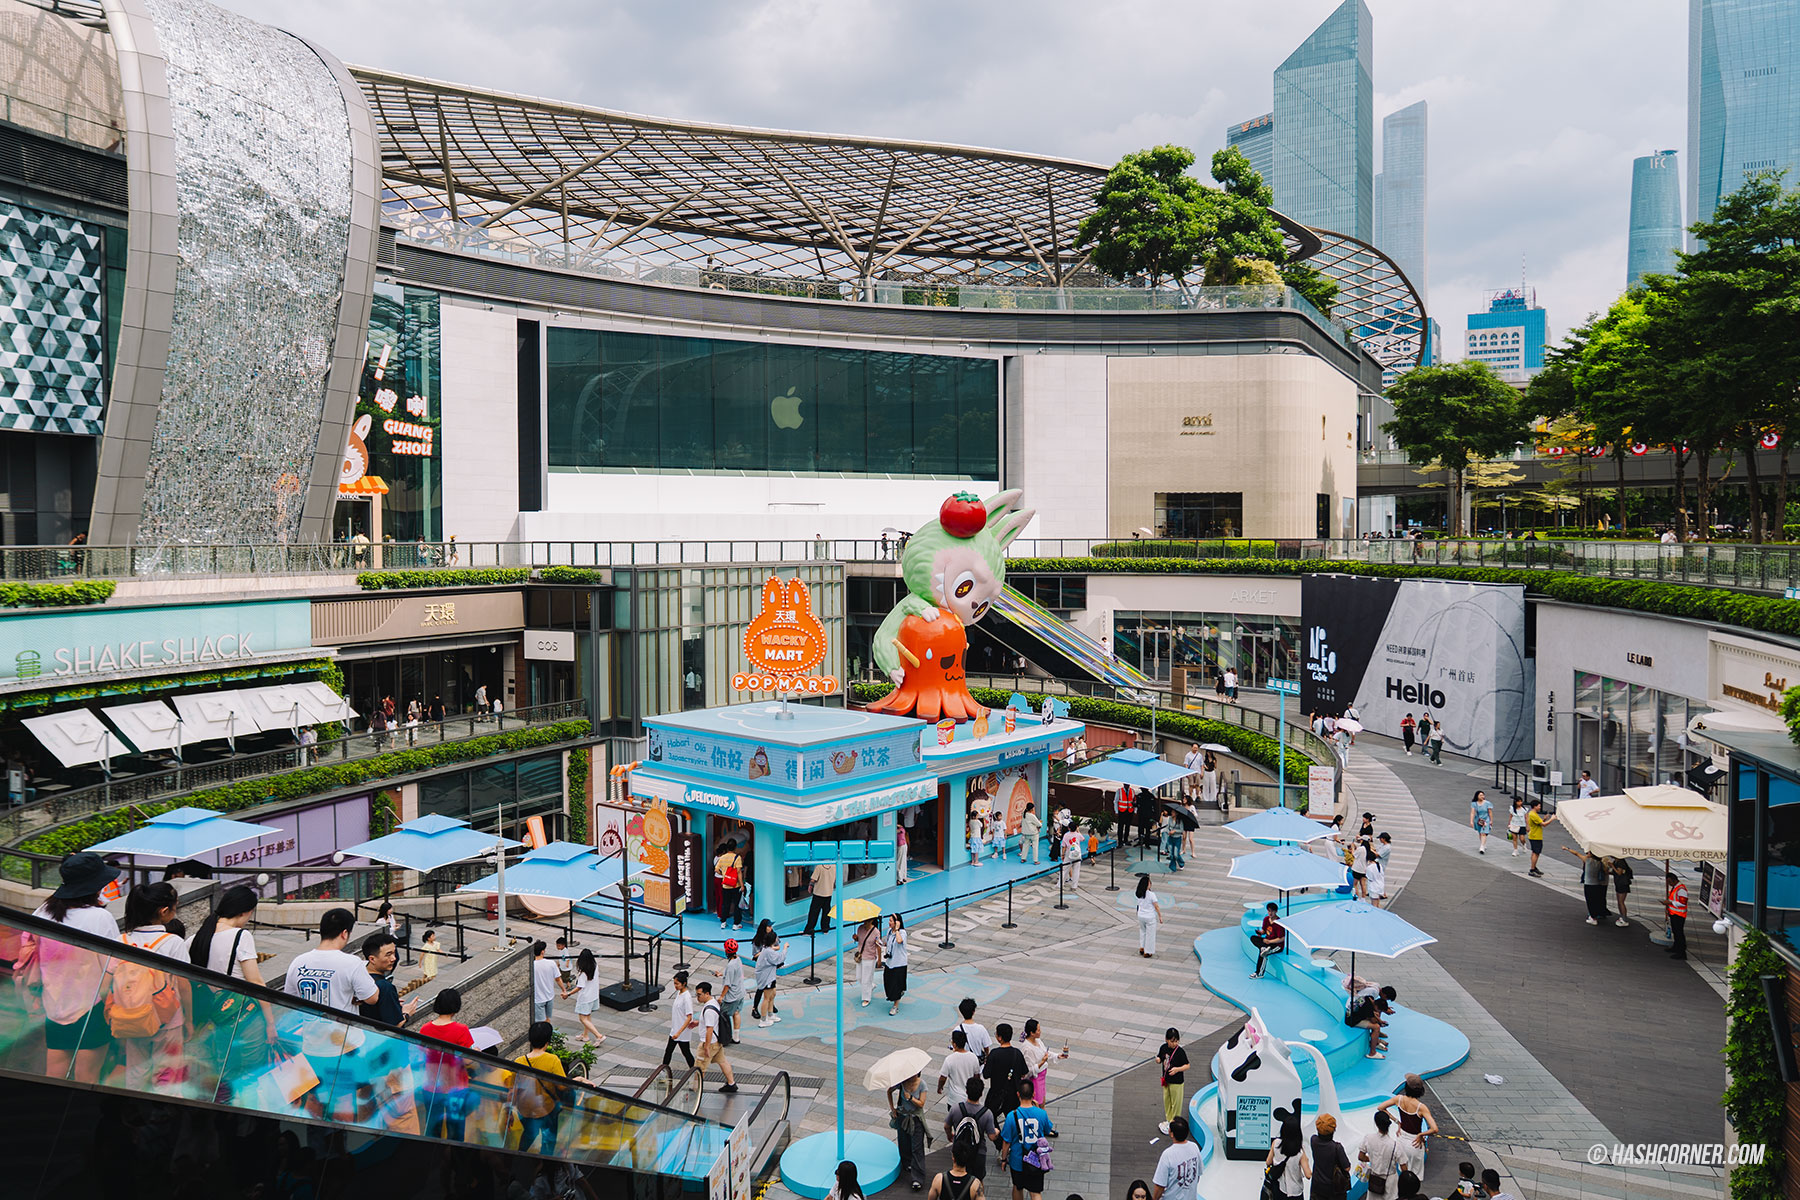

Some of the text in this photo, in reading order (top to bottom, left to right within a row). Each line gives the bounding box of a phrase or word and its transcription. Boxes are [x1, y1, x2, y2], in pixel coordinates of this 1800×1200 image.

[1650, 157, 1667, 169] IFC
[383, 419, 433, 441] GUANG
[391, 440, 432, 456] ZHOU
[1231, 590, 1277, 604] ARKET
[424, 603, 455, 622] 天環
[537, 641, 558, 651] COS
[761, 634, 808, 646] WACKY
[53, 633, 254, 675] SHAKE SHACK
[765, 649, 803, 661] MART
[1627, 652, 1653, 667] LE LABO
[1440, 667, 1476, 683] 广州首店
[735, 676, 832, 692] POPMART
[1386, 677, 1446, 709] Hello
[667, 738, 690, 748] Habari
[694, 743, 706, 752] Olá
[711, 746, 743, 771] 你好
[785, 746, 890, 781] 得闲 饮茶
[690, 790, 729, 808] DELICIOUS
[225, 846, 264, 867] BEAST
[1622, 847, 1728, 860] BUTTERFUL & CREAM
